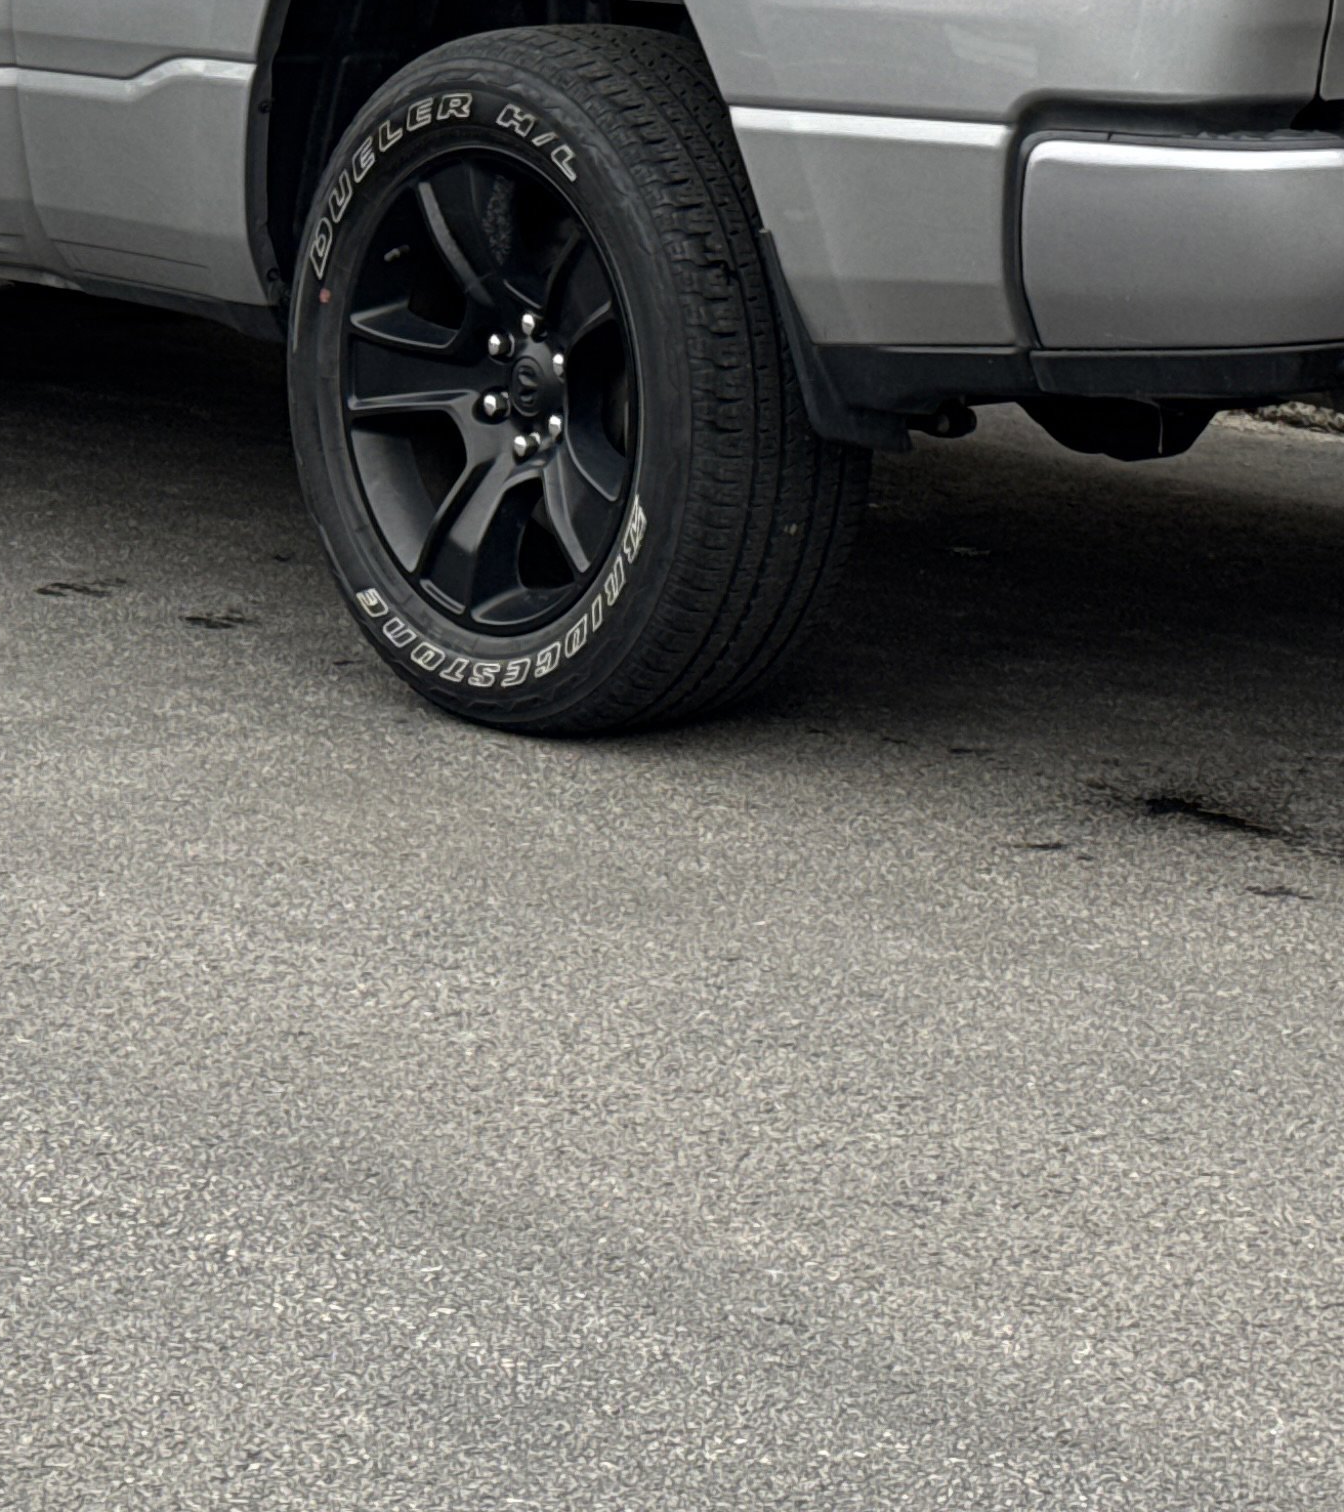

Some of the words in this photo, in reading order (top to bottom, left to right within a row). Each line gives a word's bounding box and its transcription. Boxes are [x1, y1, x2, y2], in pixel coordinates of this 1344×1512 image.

[309, 92, 472, 280] DUELER
[495, 103, 577, 182] H/L
[356, 493, 648, 687] BRIDGESTONE
